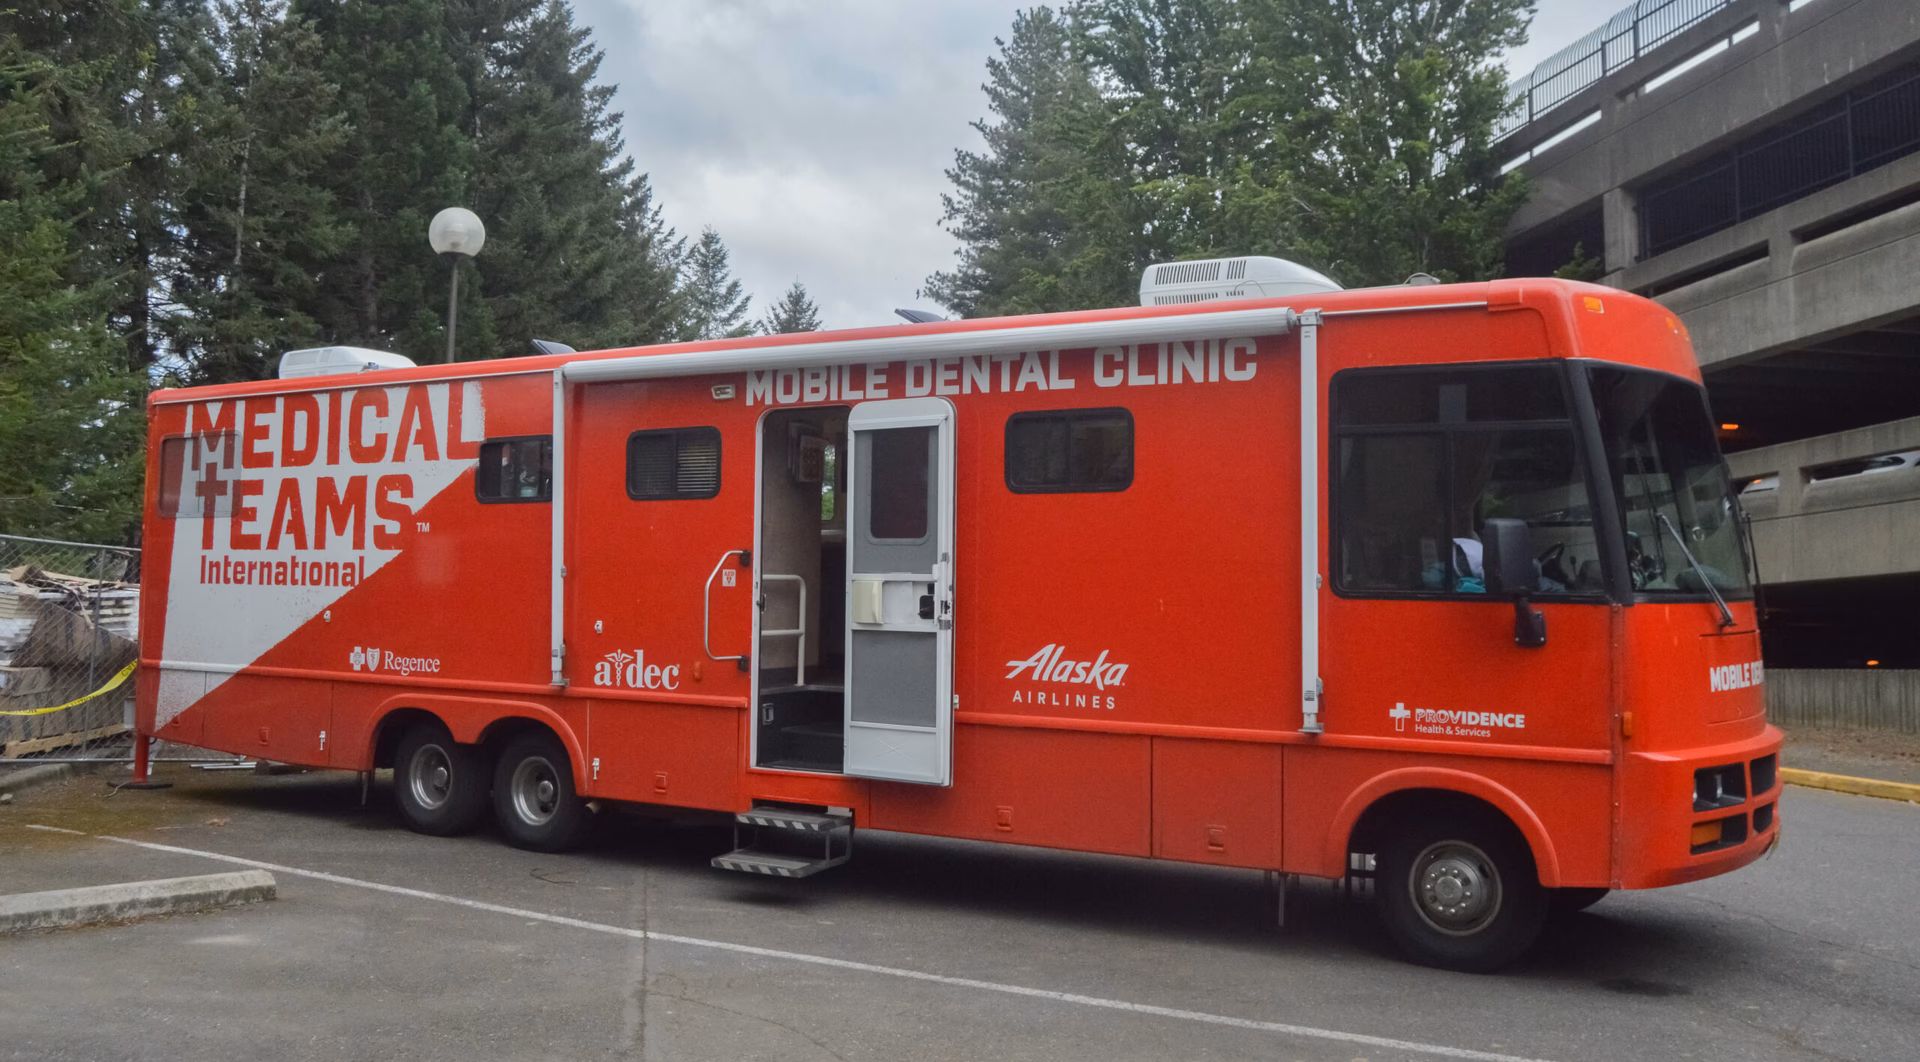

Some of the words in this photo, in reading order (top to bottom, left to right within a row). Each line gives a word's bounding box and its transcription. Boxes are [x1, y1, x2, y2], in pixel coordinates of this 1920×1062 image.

[745, 363, 889, 406] MOBILE
[905, 351, 1075, 397] DENTAL
[1093, 338, 1257, 387] CLINIC
[191, 383, 481, 470] MEDICAL
[195, 462, 415, 551] TEAMS
[200, 555, 365, 588] International
[384, 650, 441, 676] Regence
[1005, 643, 1128, 690] Alaska
[1709, 663, 1751, 692] MOBILE
[1012, 690, 1115, 709] AIRLINES
[1415, 708, 1525, 728] PROVIDENCE
[1415, 724, 1444, 735] Health
[1446, 726, 1453, 735] &
[1455, 726, 1491, 738] Services
